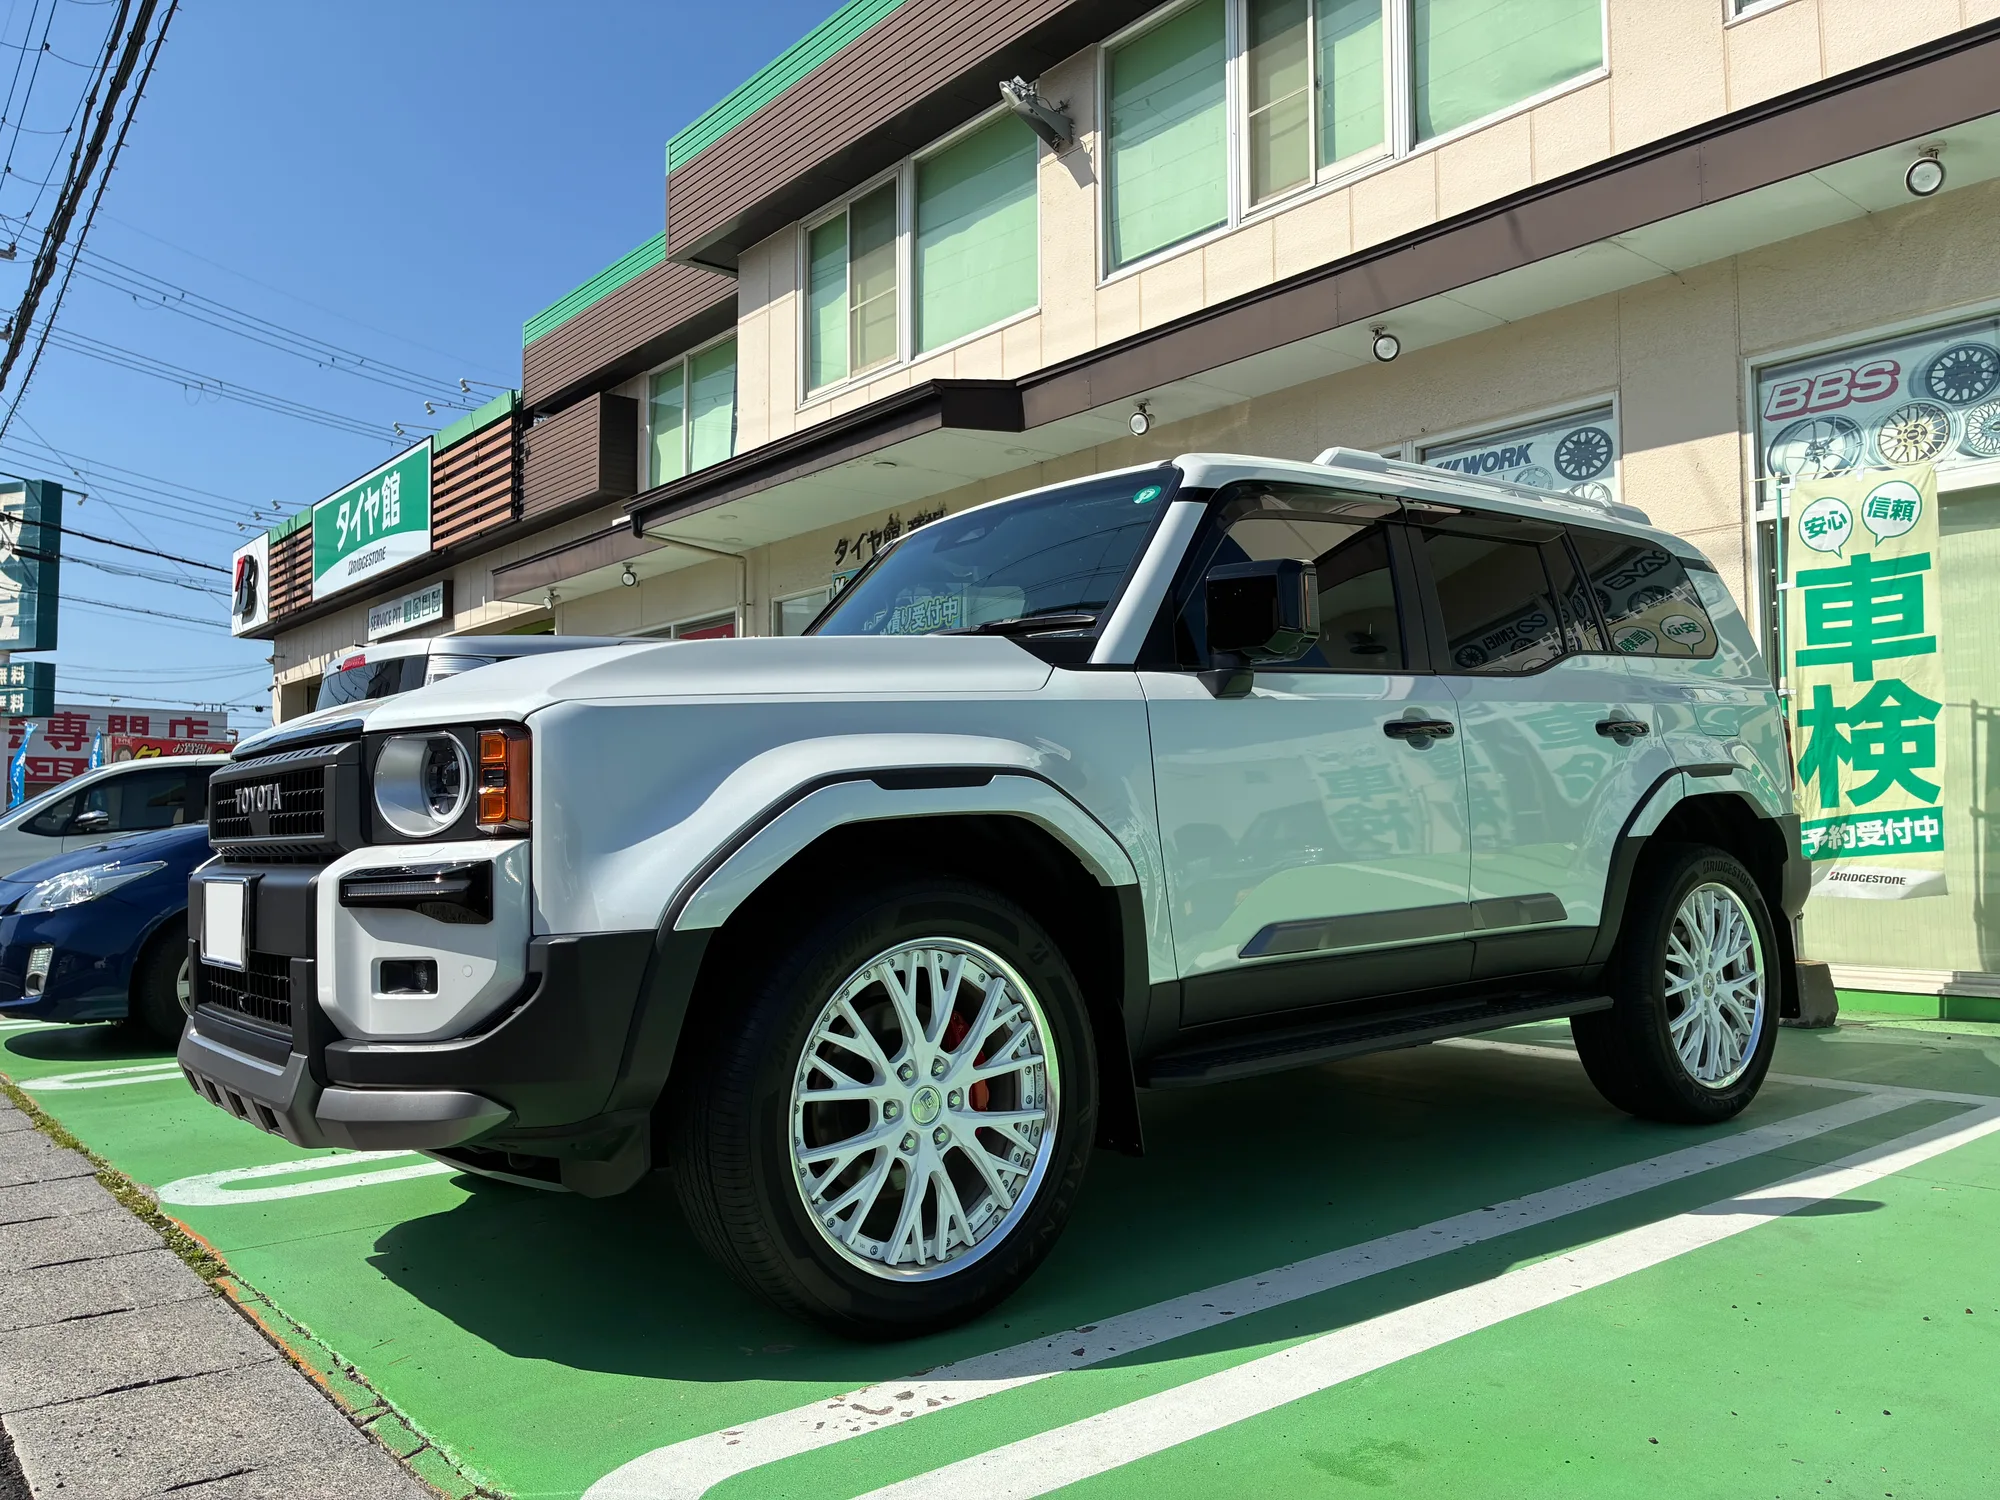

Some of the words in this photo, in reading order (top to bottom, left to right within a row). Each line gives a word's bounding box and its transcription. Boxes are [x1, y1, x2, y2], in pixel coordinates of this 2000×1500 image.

[1764, 359, 1901, 422] BBS
[1462, 442, 1534, 475] WORK
[335, 470, 401, 552] タイヤ館
[1804, 510, 1848, 539] 安心
[1866, 495, 1917, 523] 信頼
[347, 546, 387, 576] BRIDGESTONE
[370, 609, 392, 632] SERVICE
[393, 605, 402, 625] PIT
[1795, 551, 1943, 809] 車検
[235, 782, 281, 814] TOYOTA
[1801, 815, 1939, 854] 予約受付中
[1702, 860, 1756, 892] BRIDGESTONE
[1828, 871, 1907, 886] BRIDGESTONE
